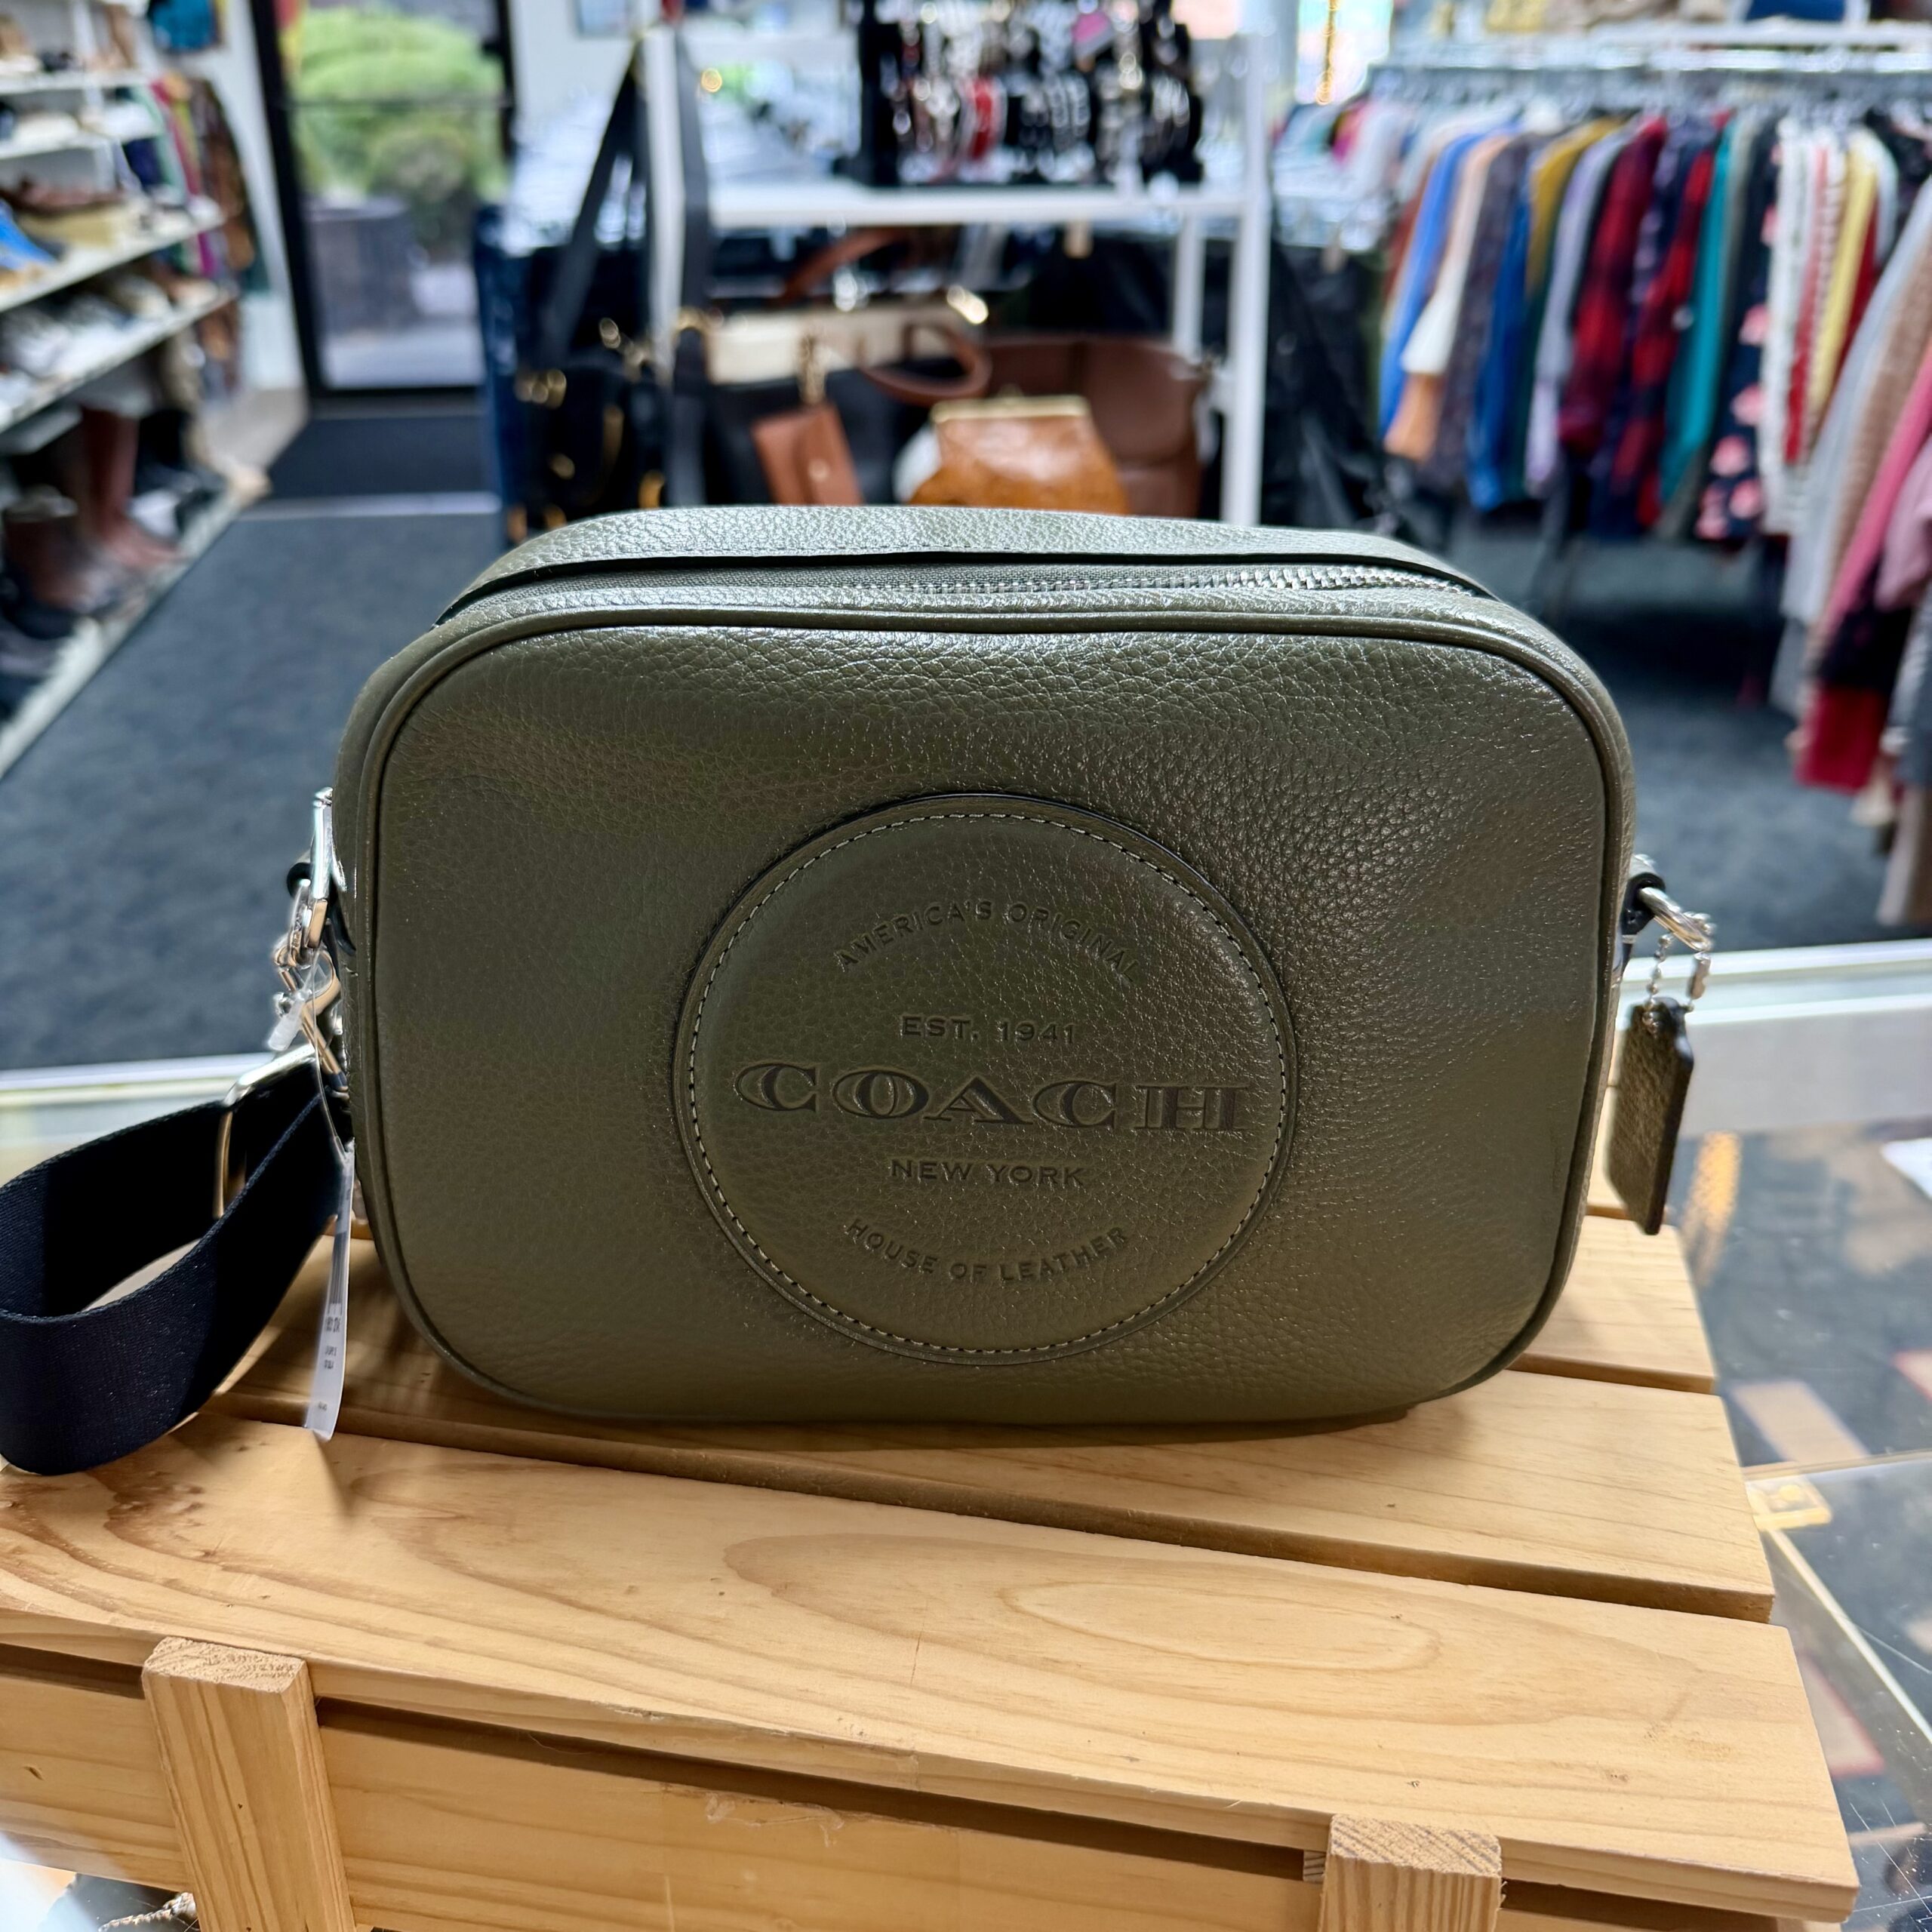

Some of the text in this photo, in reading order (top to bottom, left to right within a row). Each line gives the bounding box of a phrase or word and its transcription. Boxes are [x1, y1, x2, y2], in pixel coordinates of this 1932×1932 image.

[834, 900, 1140, 983] AMERICA'S ORIGINAL
[902, 1015, 1075, 1044] EST. 1941
[735, 1063, 1251, 1131] COACH
[891, 1159, 1085, 1186] NEW YORK
[845, 1217, 1128, 1283] HOUSE OF LEATHER
